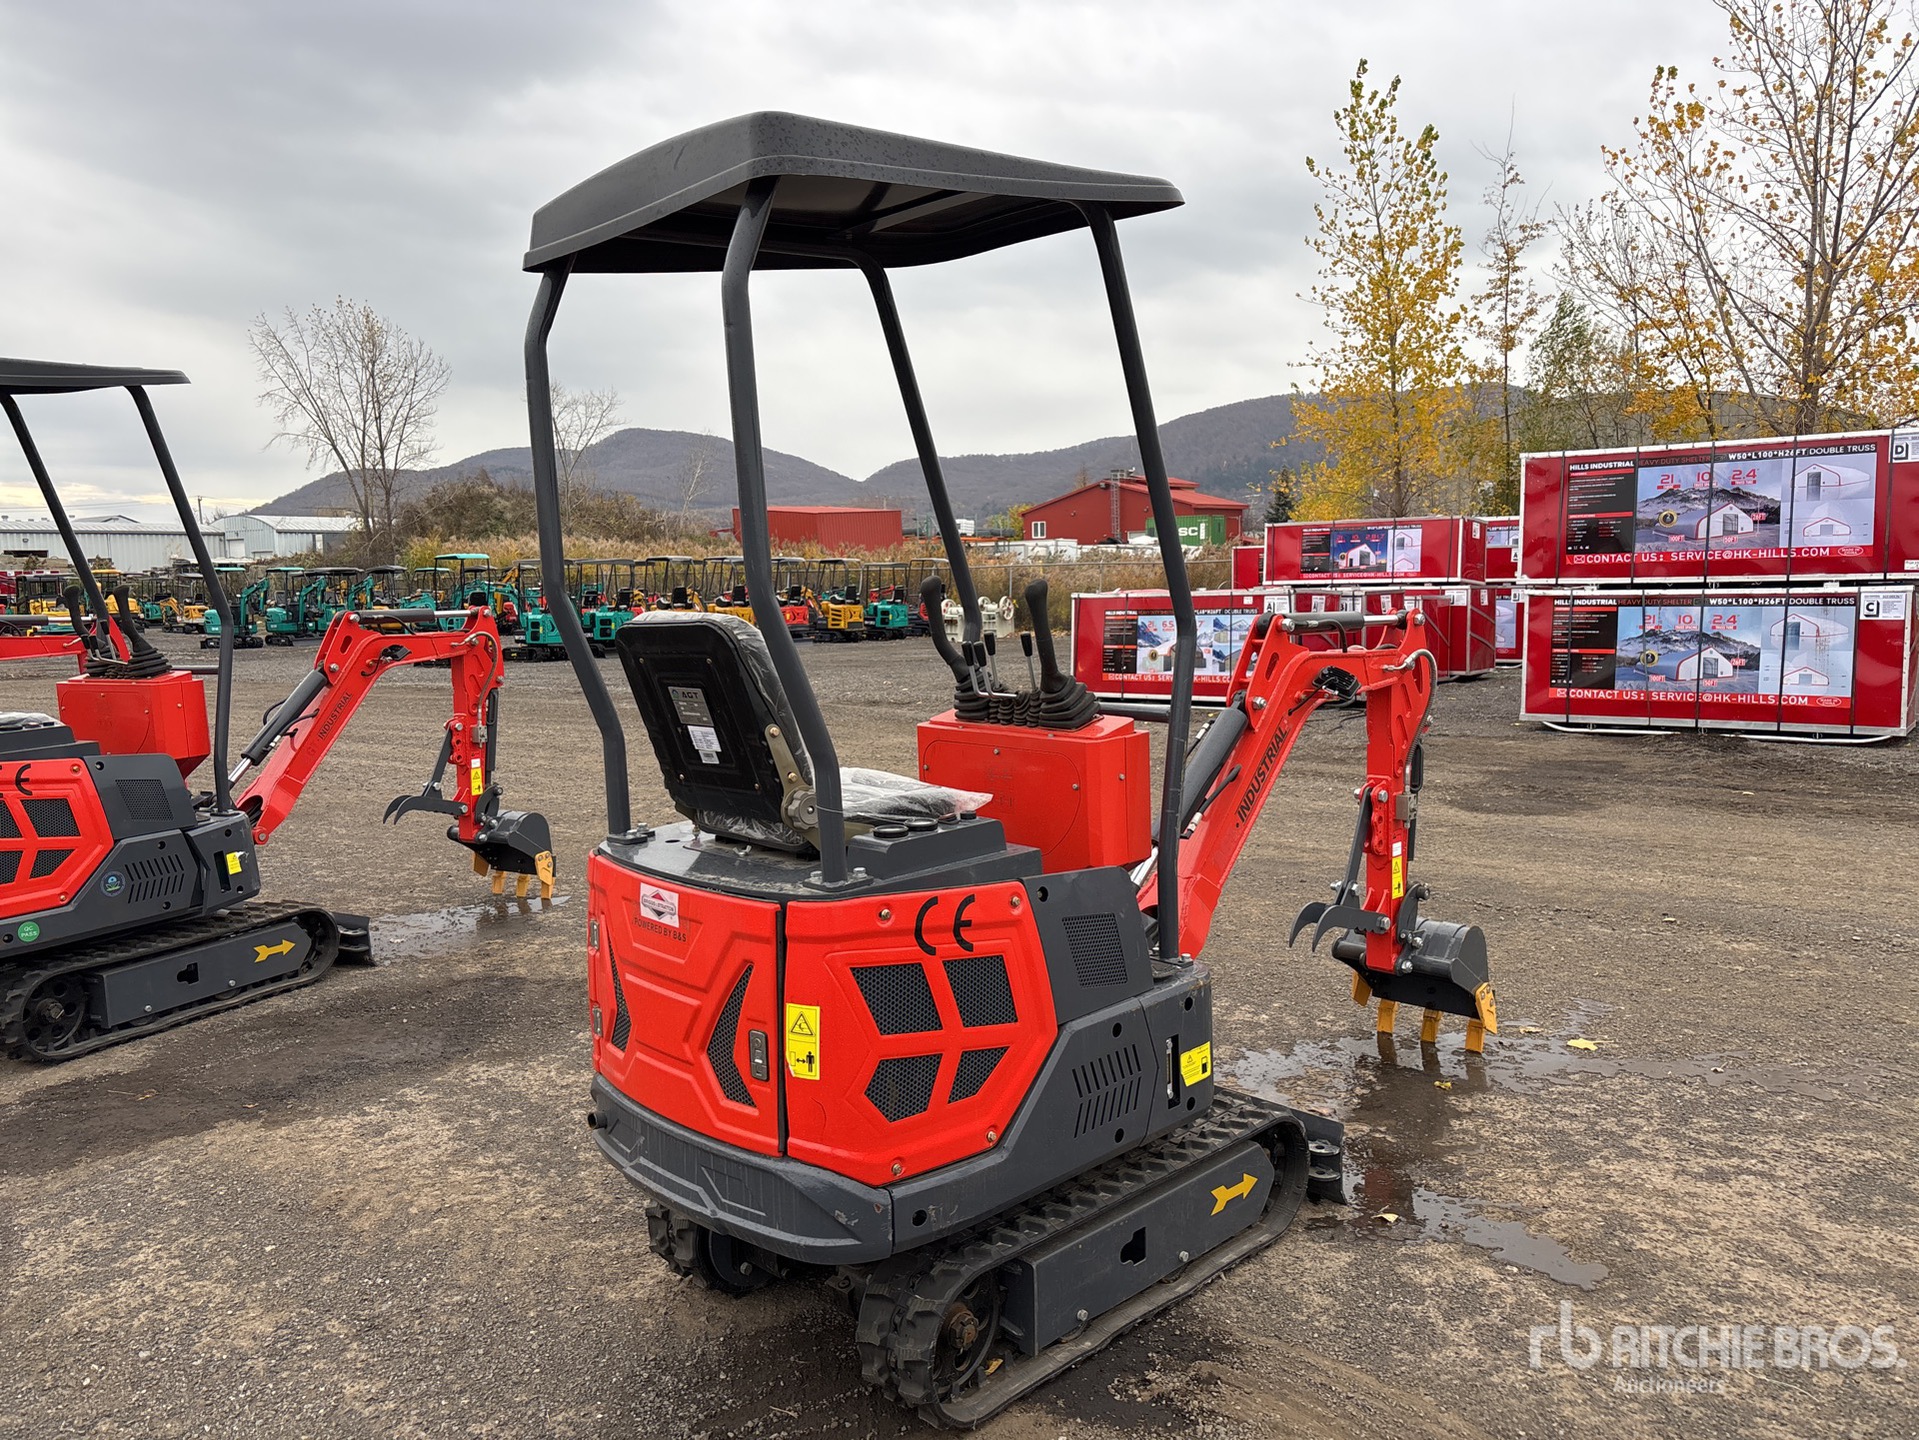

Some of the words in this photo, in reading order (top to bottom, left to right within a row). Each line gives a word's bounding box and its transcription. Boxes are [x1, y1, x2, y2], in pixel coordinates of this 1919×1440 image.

[1809, 445, 1844, 456] DOUBLE
[1847, 443, 1876, 452] TRUSS
[1894, 445, 1904, 455] D
[1569, 463, 1589, 472] HILLS
[1590, 460, 1634, 470] INDUSTRIAL
[1661, 473, 1674, 485] 21
[1573, 598, 1617, 606] INDUSTRIAL
[1789, 597, 1824, 606] DOUBLE
[1826, 597, 1855, 605] TRUSS
[1865, 601, 1875, 612] C
[1569, 688, 1618, 699] CONTACT
[318, 692, 352, 740] INDUSTRIAL
[1237, 725, 1289, 824] INDUSTRIAL
[634, 917, 663, 935] POWERED
[663, 927, 672, 938] BY
[673, 930, 687, 943] B&S
[914, 893, 976, 956] CE
